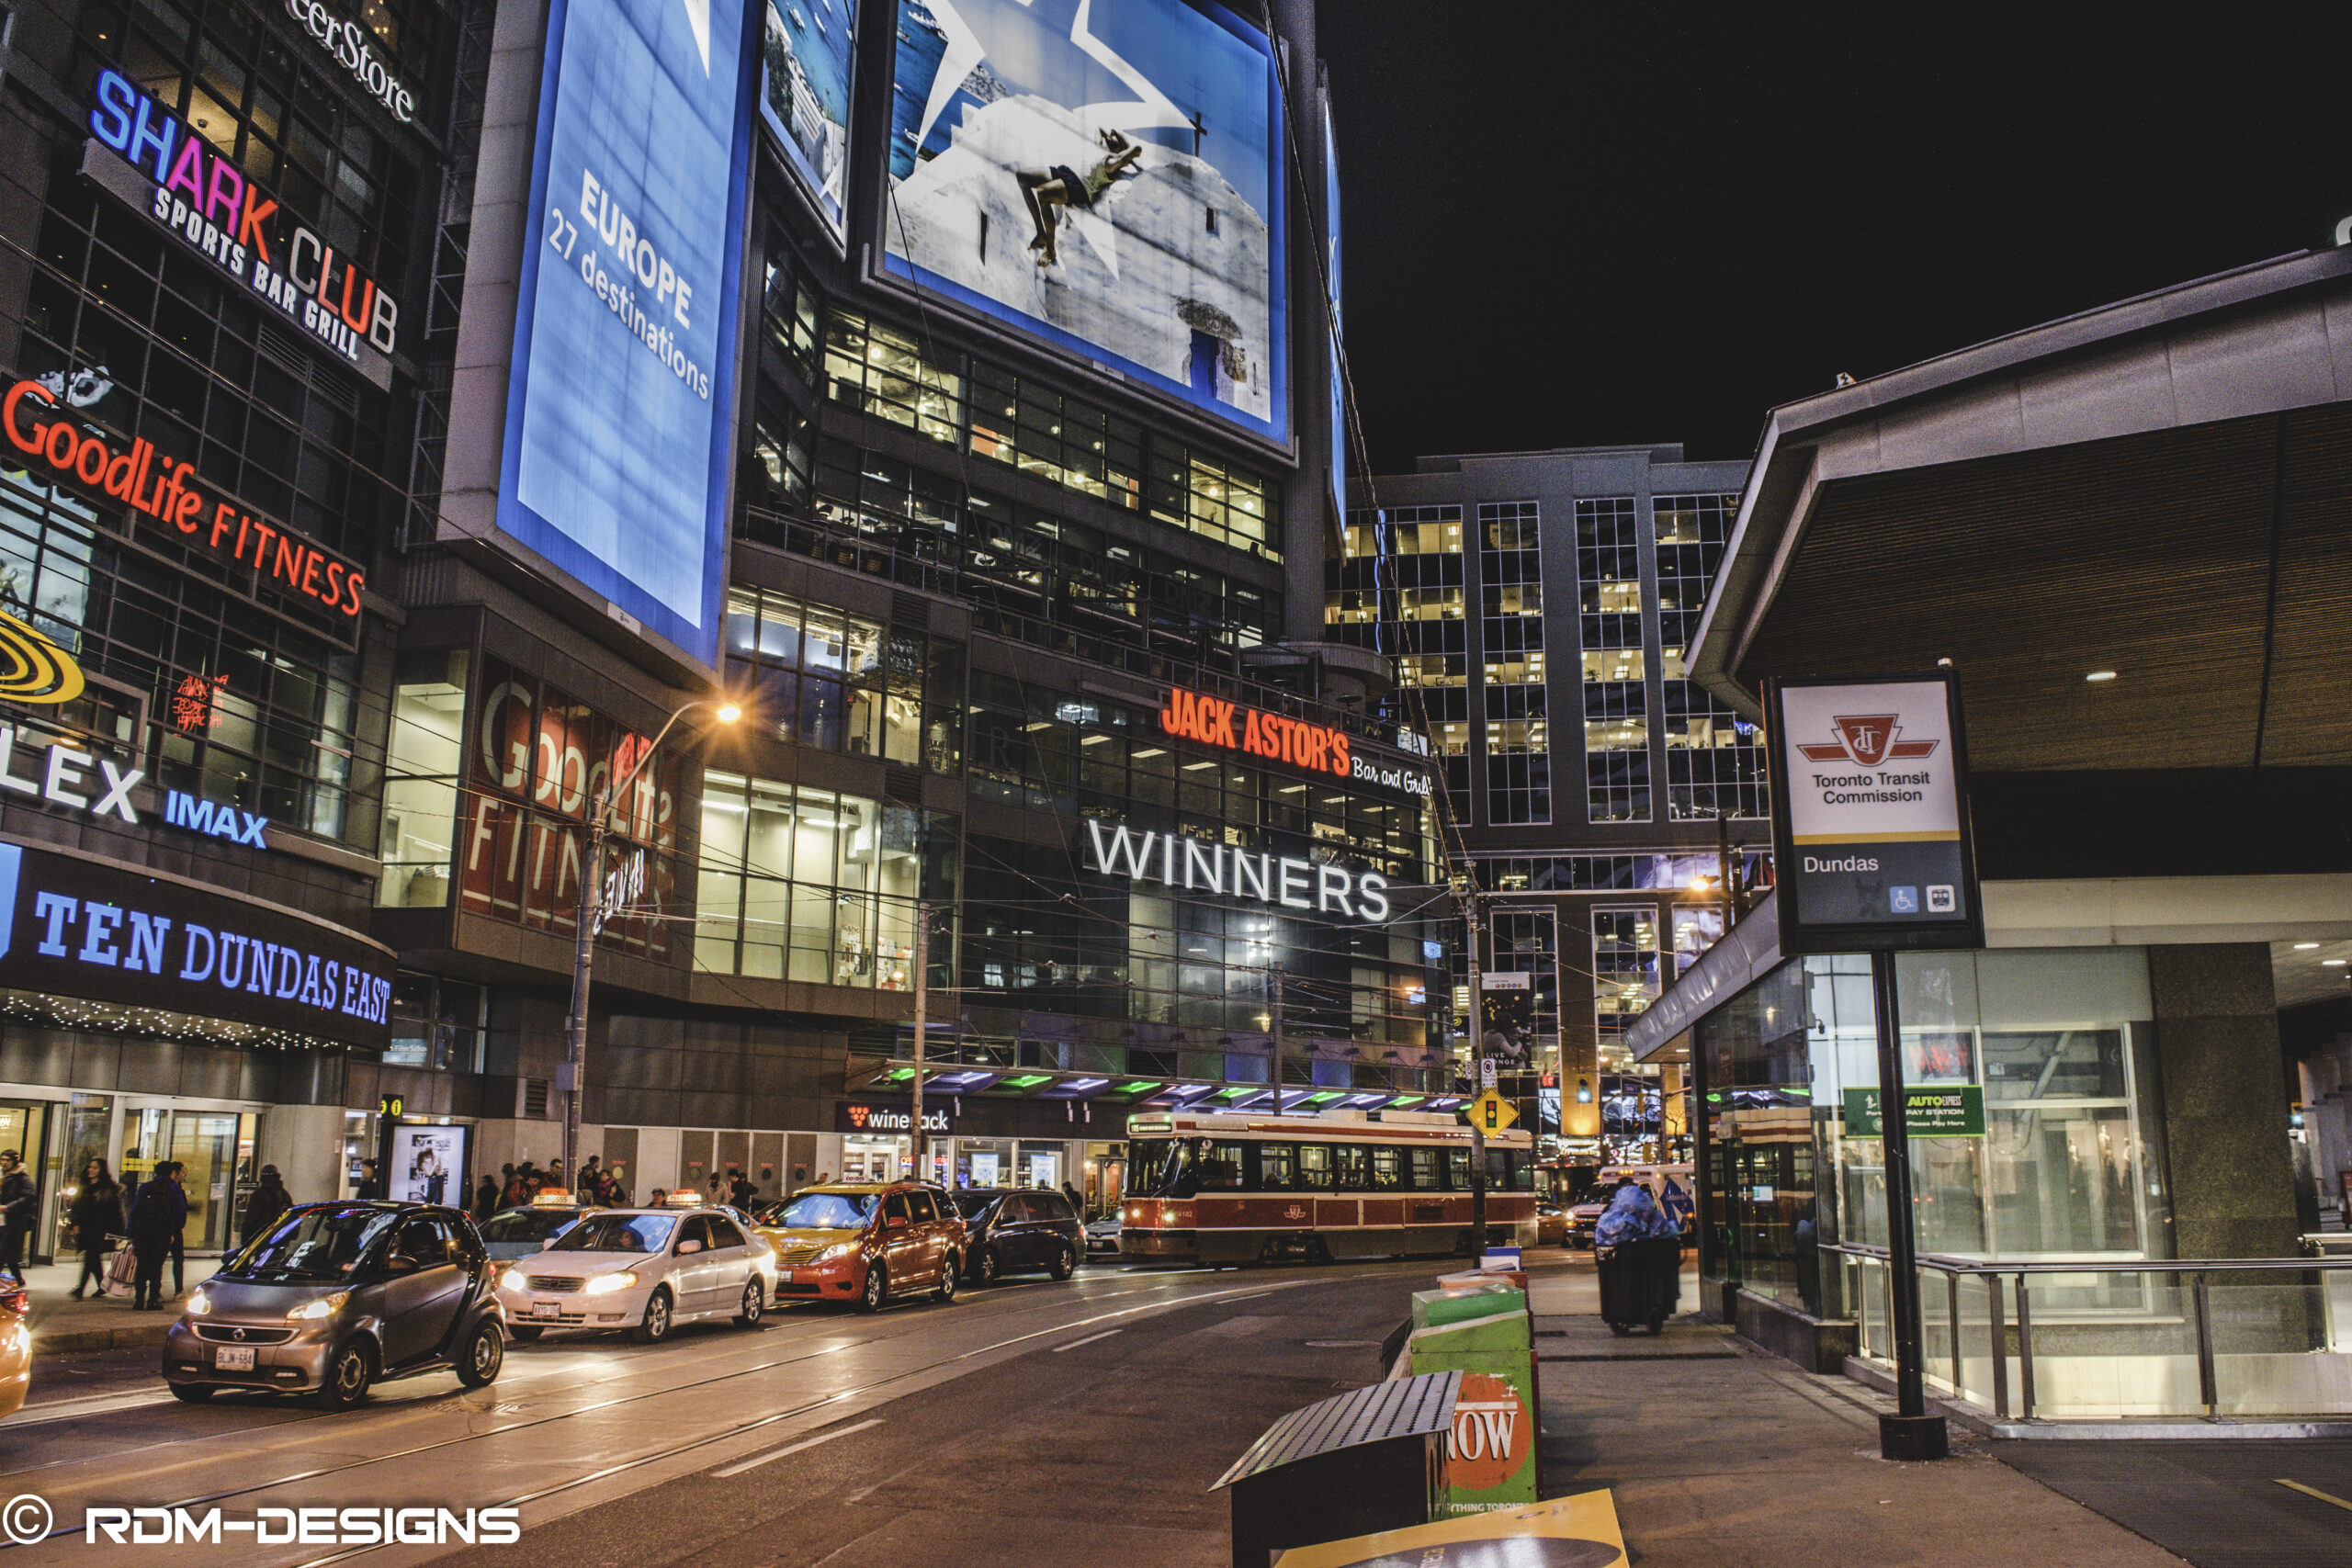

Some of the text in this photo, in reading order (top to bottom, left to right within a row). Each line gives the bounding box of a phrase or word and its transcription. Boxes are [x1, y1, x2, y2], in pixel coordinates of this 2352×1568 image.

[91, 69, 398, 355] SHARK CLUB
[580, 168, 693, 330] EUROPE
[154, 186, 358, 361] SPORTS BAR GRILL
[549, 208, 708, 400] 27 destinations
[3, 380, 364, 616] GoodLife FITNESS
[0, 728, 145, 824] LEX
[1161, 688, 1351, 777] JACK ASTOR'S
[1351, 756, 1378, 783] Bar
[1382, 769, 1401, 789] and
[165, 789, 268, 850] IMAX
[1813, 772, 1930, 788] Toronto Transit
[1823, 790, 1923, 805] Commission
[1089, 819, 1388, 922] WINNERS
[1804, 856, 1879, 874] Dundas
[35, 891, 390, 1026] TEN DUNDAS EAST
[868, 1110, 949, 1131] wineack
[1907, 1096, 1942, 1107] AUTO
[1486, 1502, 1531, 1512] TORONT
